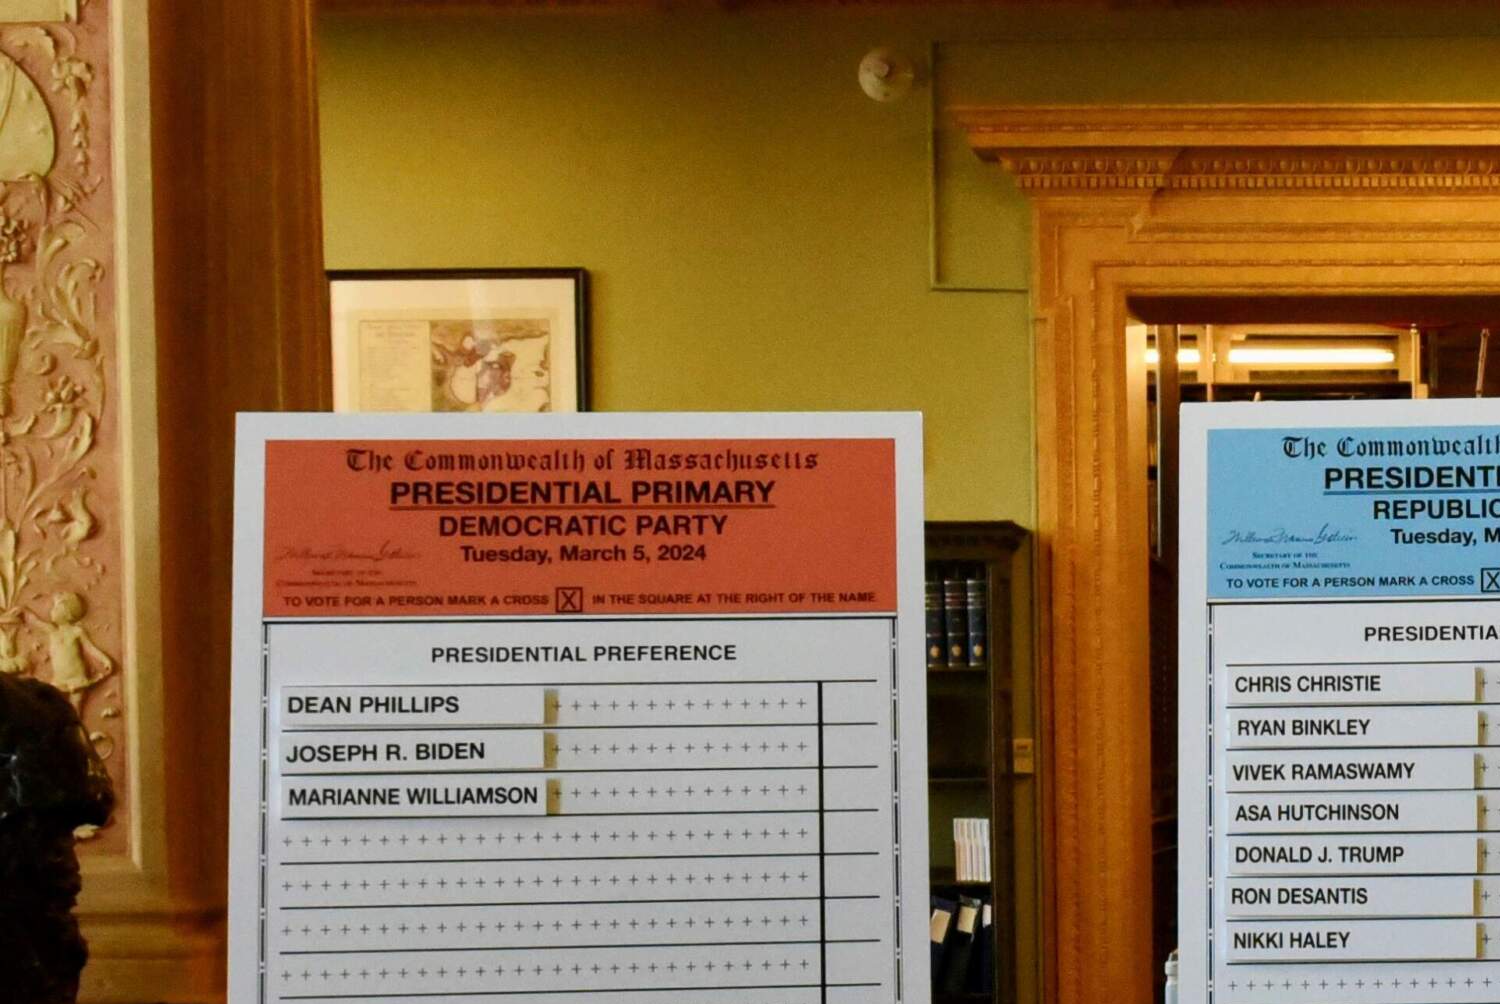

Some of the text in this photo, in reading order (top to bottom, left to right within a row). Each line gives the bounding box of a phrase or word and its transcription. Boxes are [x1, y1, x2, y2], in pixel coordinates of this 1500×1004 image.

[1283, 436, 1326, 460] The
[346, 448, 818, 473] The Commonwealth of Massachusetts
[390, 480, 775, 505] PRESIDENTIAL PRIMARY
[439, 514, 728, 537] DEMOCRATIC PARTY
[1389, 528, 1477, 547] Tuesday,
[460, 544, 707, 566] Tuesday, March 5, 2024
[1226, 578, 1244, 589] TO
[1246, 578, 1279, 588] VOTE
[1283, 577, 1308, 588] FOR
[1311, 577, 1321, 587] A
[1324, 576, 1375, 588] PERSON
[1379, 576, 1416, 586] MARK
[1419, 576, 1428, 586] A
[1431, 575, 1475, 586] CROSS
[1486, 571, 1500, 593] X
[283, 596, 302, 607] TO
[304, 596, 339, 607] VOTE
[344, 595, 372, 607] FOR
[375, 596, 385, 606] A
[388, 595, 444, 607] PERSON
[447, 595, 486, 606] MARK
[490, 595, 500, 606] A
[502, 594, 549, 606] CROSS
[561, 590, 577, 612] X
[592, 594, 605, 605] IN
[609, 594, 634, 605] THE
[638, 593, 692, 605] SQUARE
[696, 593, 711, 604] AT
[717, 593, 741, 604] THE
[745, 592, 785, 604] RIGHT
[788, 592, 805, 604] OF
[810, 592, 835, 603] THE
[431, 644, 737, 663] PRESIDENTIAL PREFERENCE
[1235, 675, 1381, 693] CHRIS CHRISTIE
[288, 696, 459, 714] DEAN PHILLIPS
[1238, 719, 1371, 736] RYAN BINKLEY
[286, 742, 485, 763] JOSEPH R. BIDEN
[1232, 762, 1415, 781] VIVEK RAMASWAMY
[289, 786, 538, 806] MARIANNE WILLIAMSON
[1235, 803, 1399, 822] ASA HUTCHINSON
[1235, 846, 1404, 863] DONALD J. TRUMP
[1231, 887, 1368, 905] RON DESANTIS
[1234, 931, 1350, 949] NIKKI HALEY
